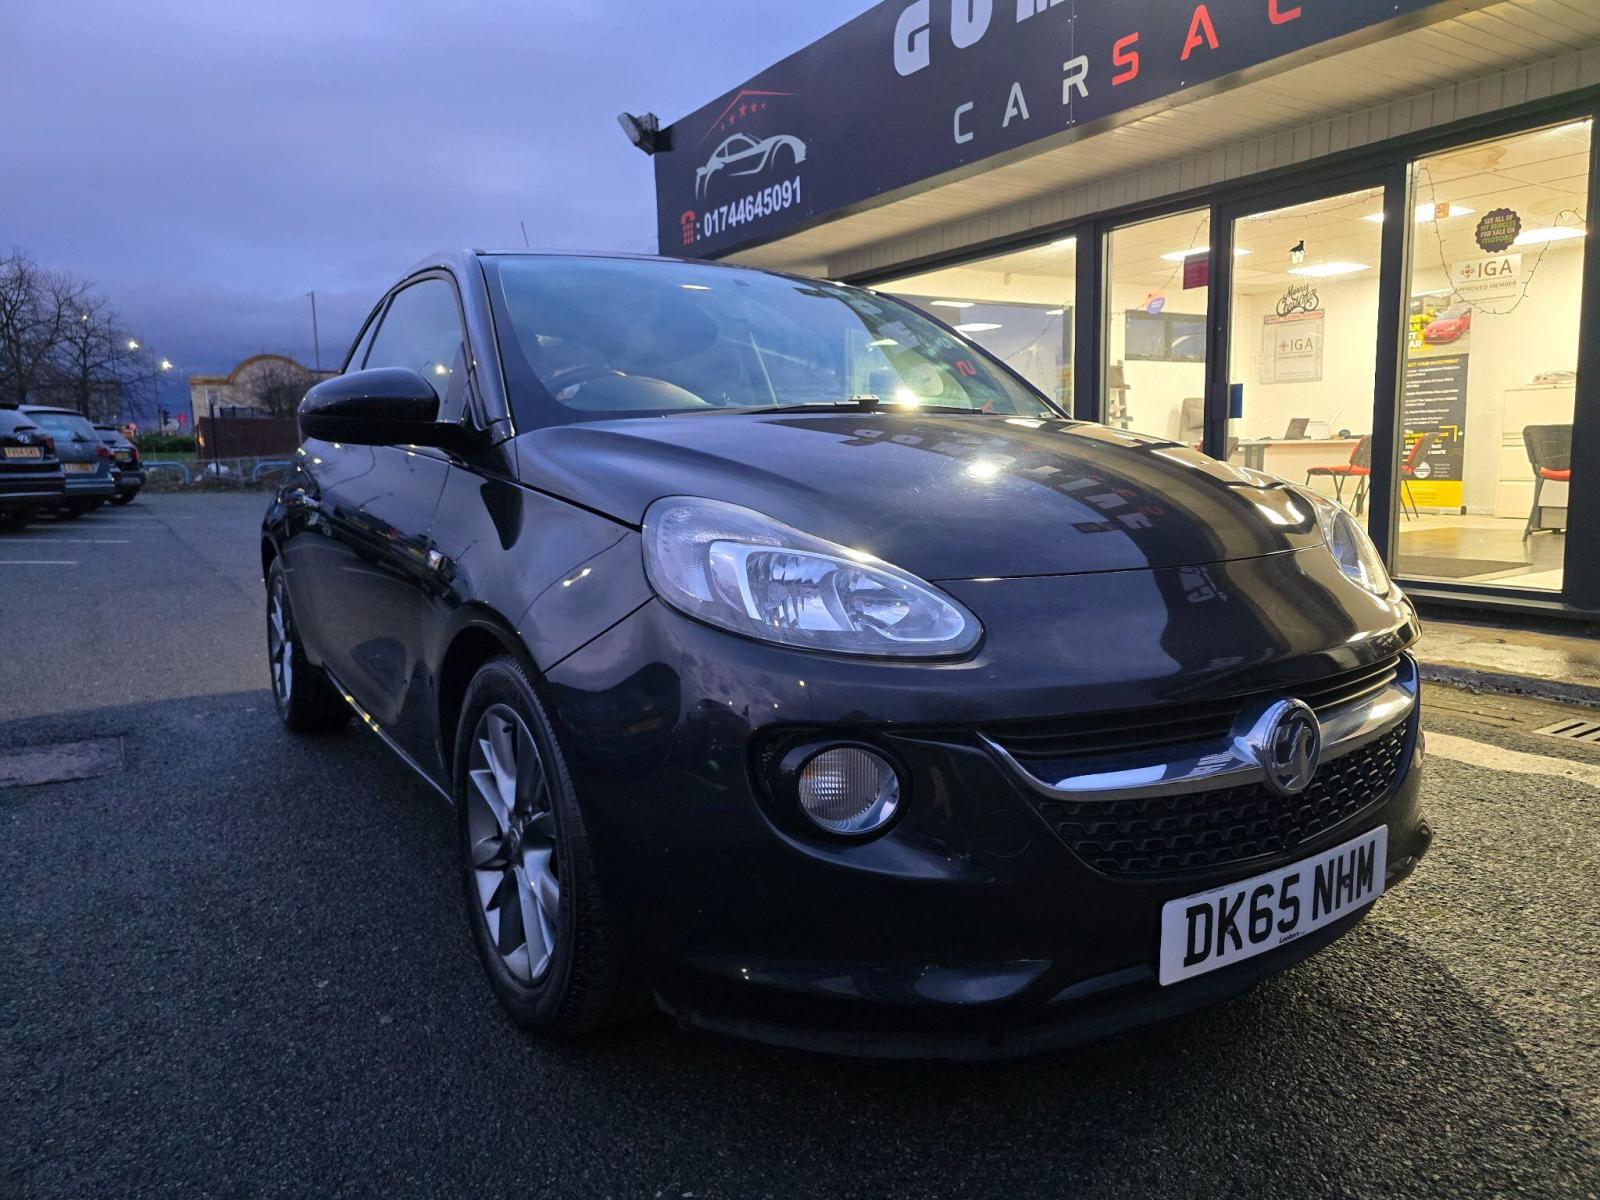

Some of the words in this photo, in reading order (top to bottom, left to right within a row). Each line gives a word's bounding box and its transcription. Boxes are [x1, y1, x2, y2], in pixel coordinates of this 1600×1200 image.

[1492, 228, 1506, 236] SALE
[1478, 259, 1512, 278] IGA
[1489, 281, 1517, 289] MEMBER
[1290, 337, 1313, 351] IGA
[1183, 873, 1301, 967] DK65
[1312, 840, 1376, 921] NHM
